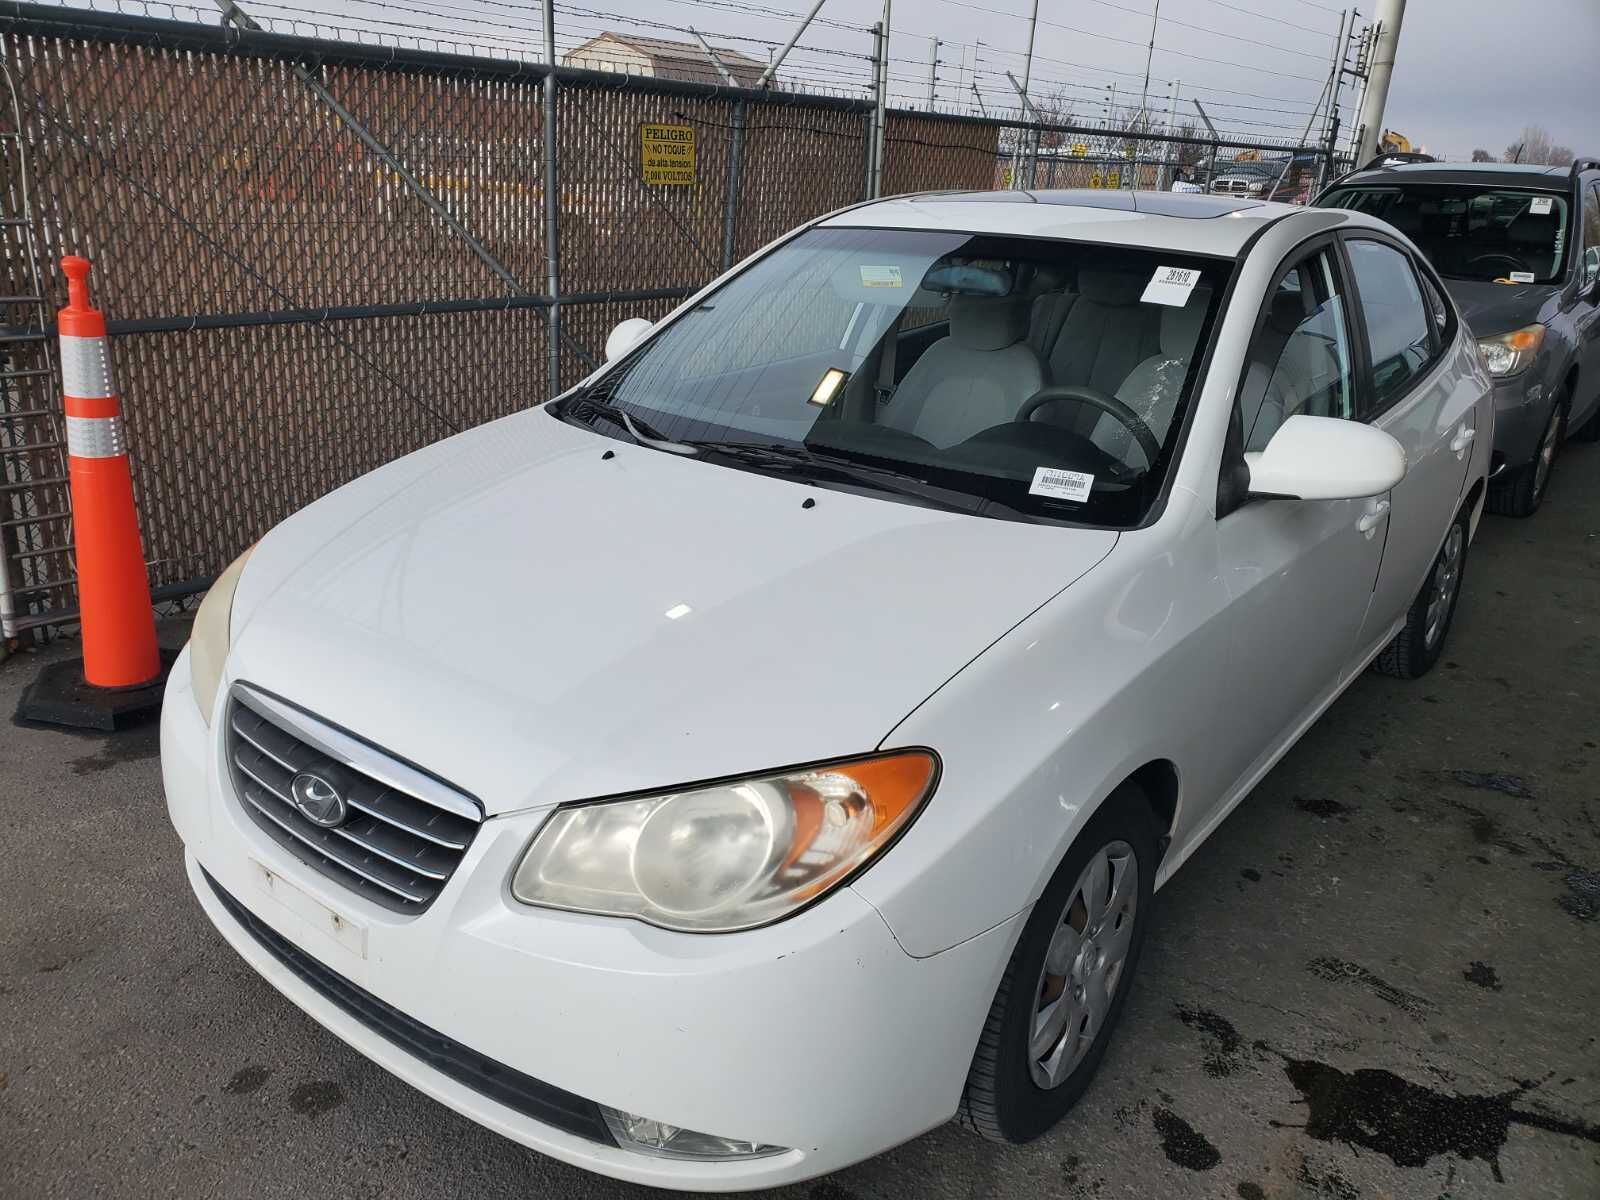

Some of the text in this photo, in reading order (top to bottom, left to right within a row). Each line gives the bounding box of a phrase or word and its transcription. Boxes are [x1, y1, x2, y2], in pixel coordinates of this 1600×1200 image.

[645, 128, 693, 141] PELIGRO
[652, 144, 686, 155] NO TOQUE
[663, 171, 693, 182] VOLTIOS
